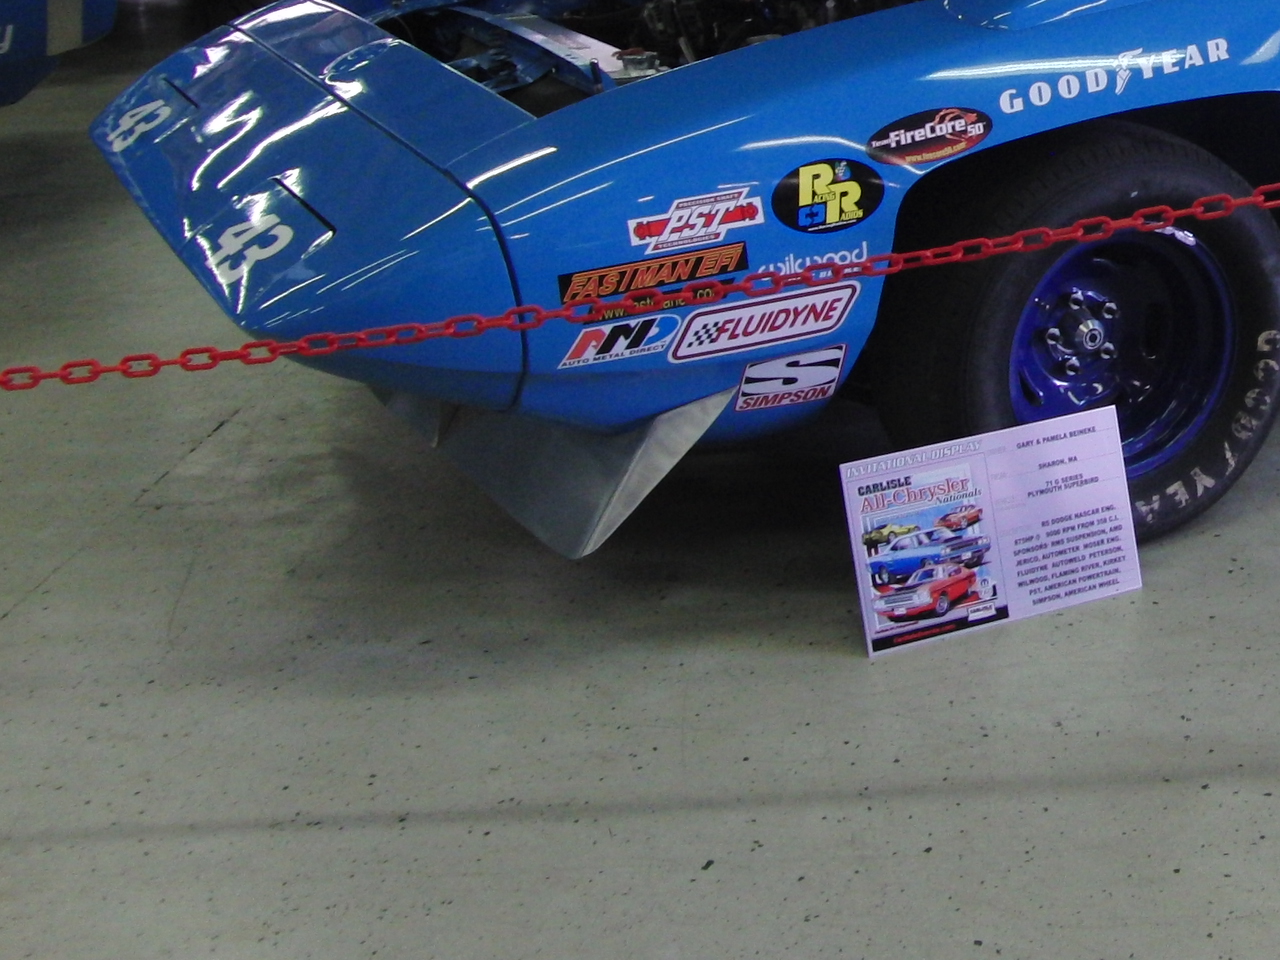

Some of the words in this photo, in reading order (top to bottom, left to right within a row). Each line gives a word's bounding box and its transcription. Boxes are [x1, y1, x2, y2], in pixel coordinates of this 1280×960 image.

[999, 38, 1230, 114] GOODYEAR
[107, 99, 172, 152] 43
[889, 119, 966, 148] FireCore
[657, 200, 736, 241] PST
[205, 214, 294, 284] 43
[713, 297, 843, 343] FLUIDYNE
[561, 356, 589, 367] AUTO
[593, 351, 625, 362] METAL
[629, 344, 665, 355] DIRECT
[740, 385, 832, 409] SIMPSON
[1017, 439, 1034, 449] GARY
[1042, 433, 1067, 444] PAMELA
[1069, 426, 1096, 438] BEINEKE
[847, 452, 927, 478] INVITATIONAL
[931, 439, 982, 460] DISPLAY
[858, 476, 912, 497] CARLISLE
[1027, 485, 1062, 498] PLYMOUTH
[1063, 476, 1099, 490] SUPERBIRD
[1061, 473, 1083, 483] SERIES
[860, 477, 969, 513] All-Chrysler
[935, 488, 982, 505] Nationals
[1051, 514, 1072, 525] DODGE
[1074, 507, 1100, 519] NASCAR
[1077, 521, 1095, 530] FROM
[1051, 567, 1080, 579] FLAMING
[1044, 578, 1077, 592] AMERICAN
[1064, 584, 1097, 597] AMERICAN
[1098, 578, 1120, 589] WHEEL
